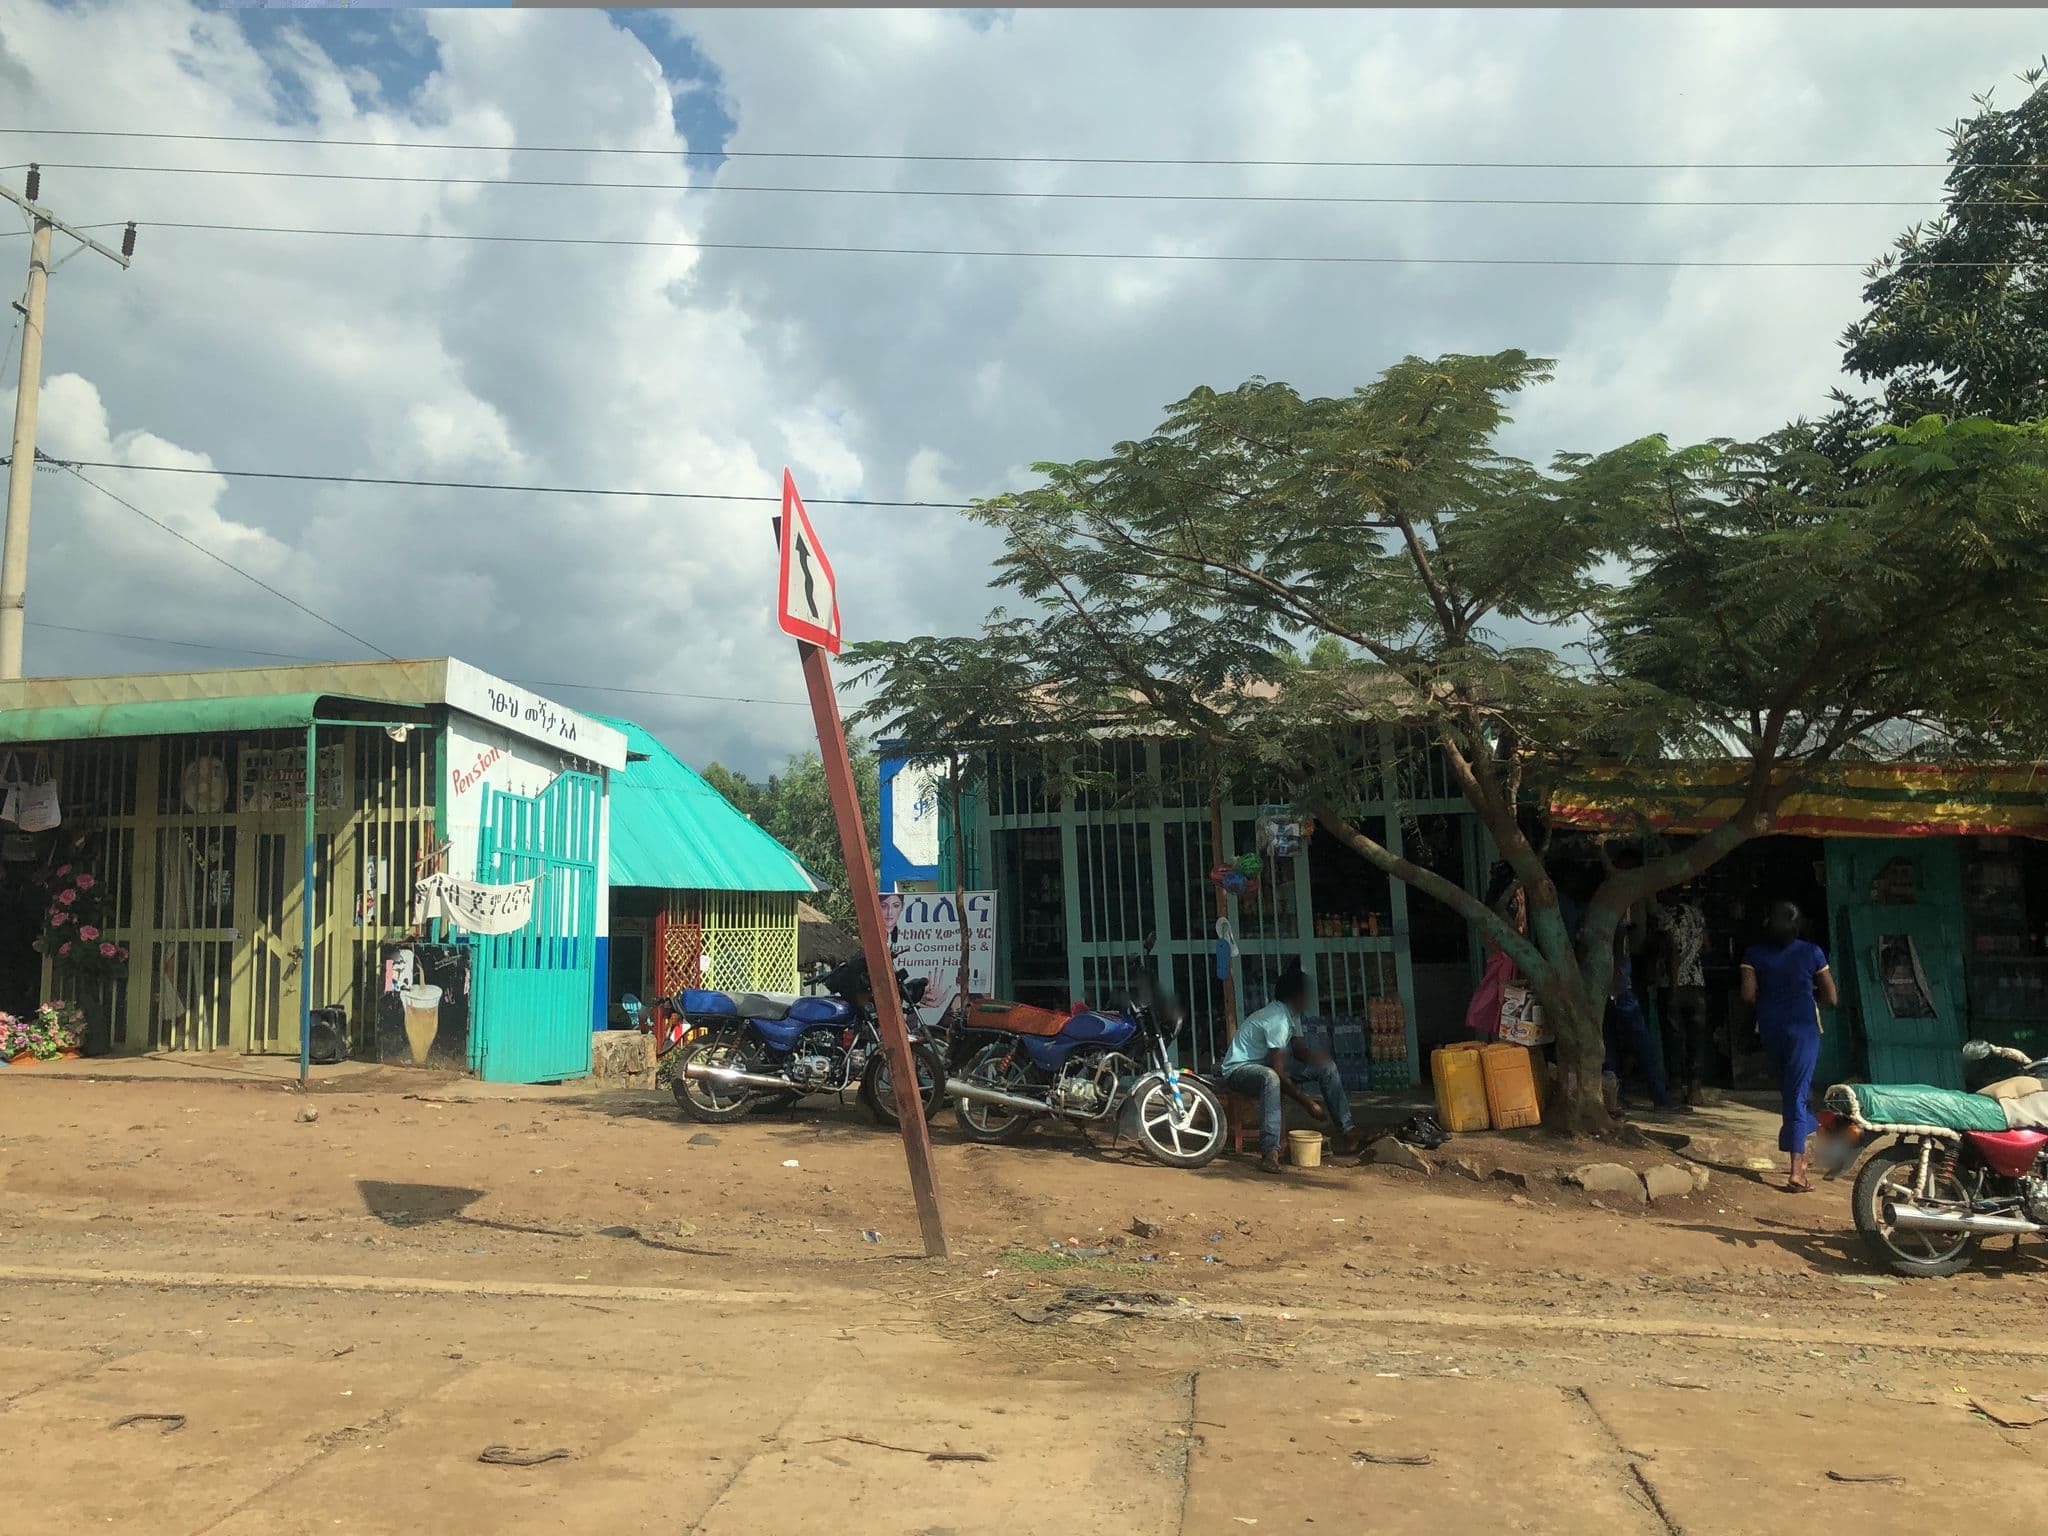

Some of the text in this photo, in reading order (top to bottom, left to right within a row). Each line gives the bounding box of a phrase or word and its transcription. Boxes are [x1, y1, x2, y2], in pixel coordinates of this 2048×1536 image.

[525, 699, 556, 733] መኝታ
[560, 717, 576, 741] አለ
[452, 746, 500, 797] Pension
[914, 942, 977, 952] Cosmets
[980, 941, 989, 952] &
[897, 957, 939, 966] Human
